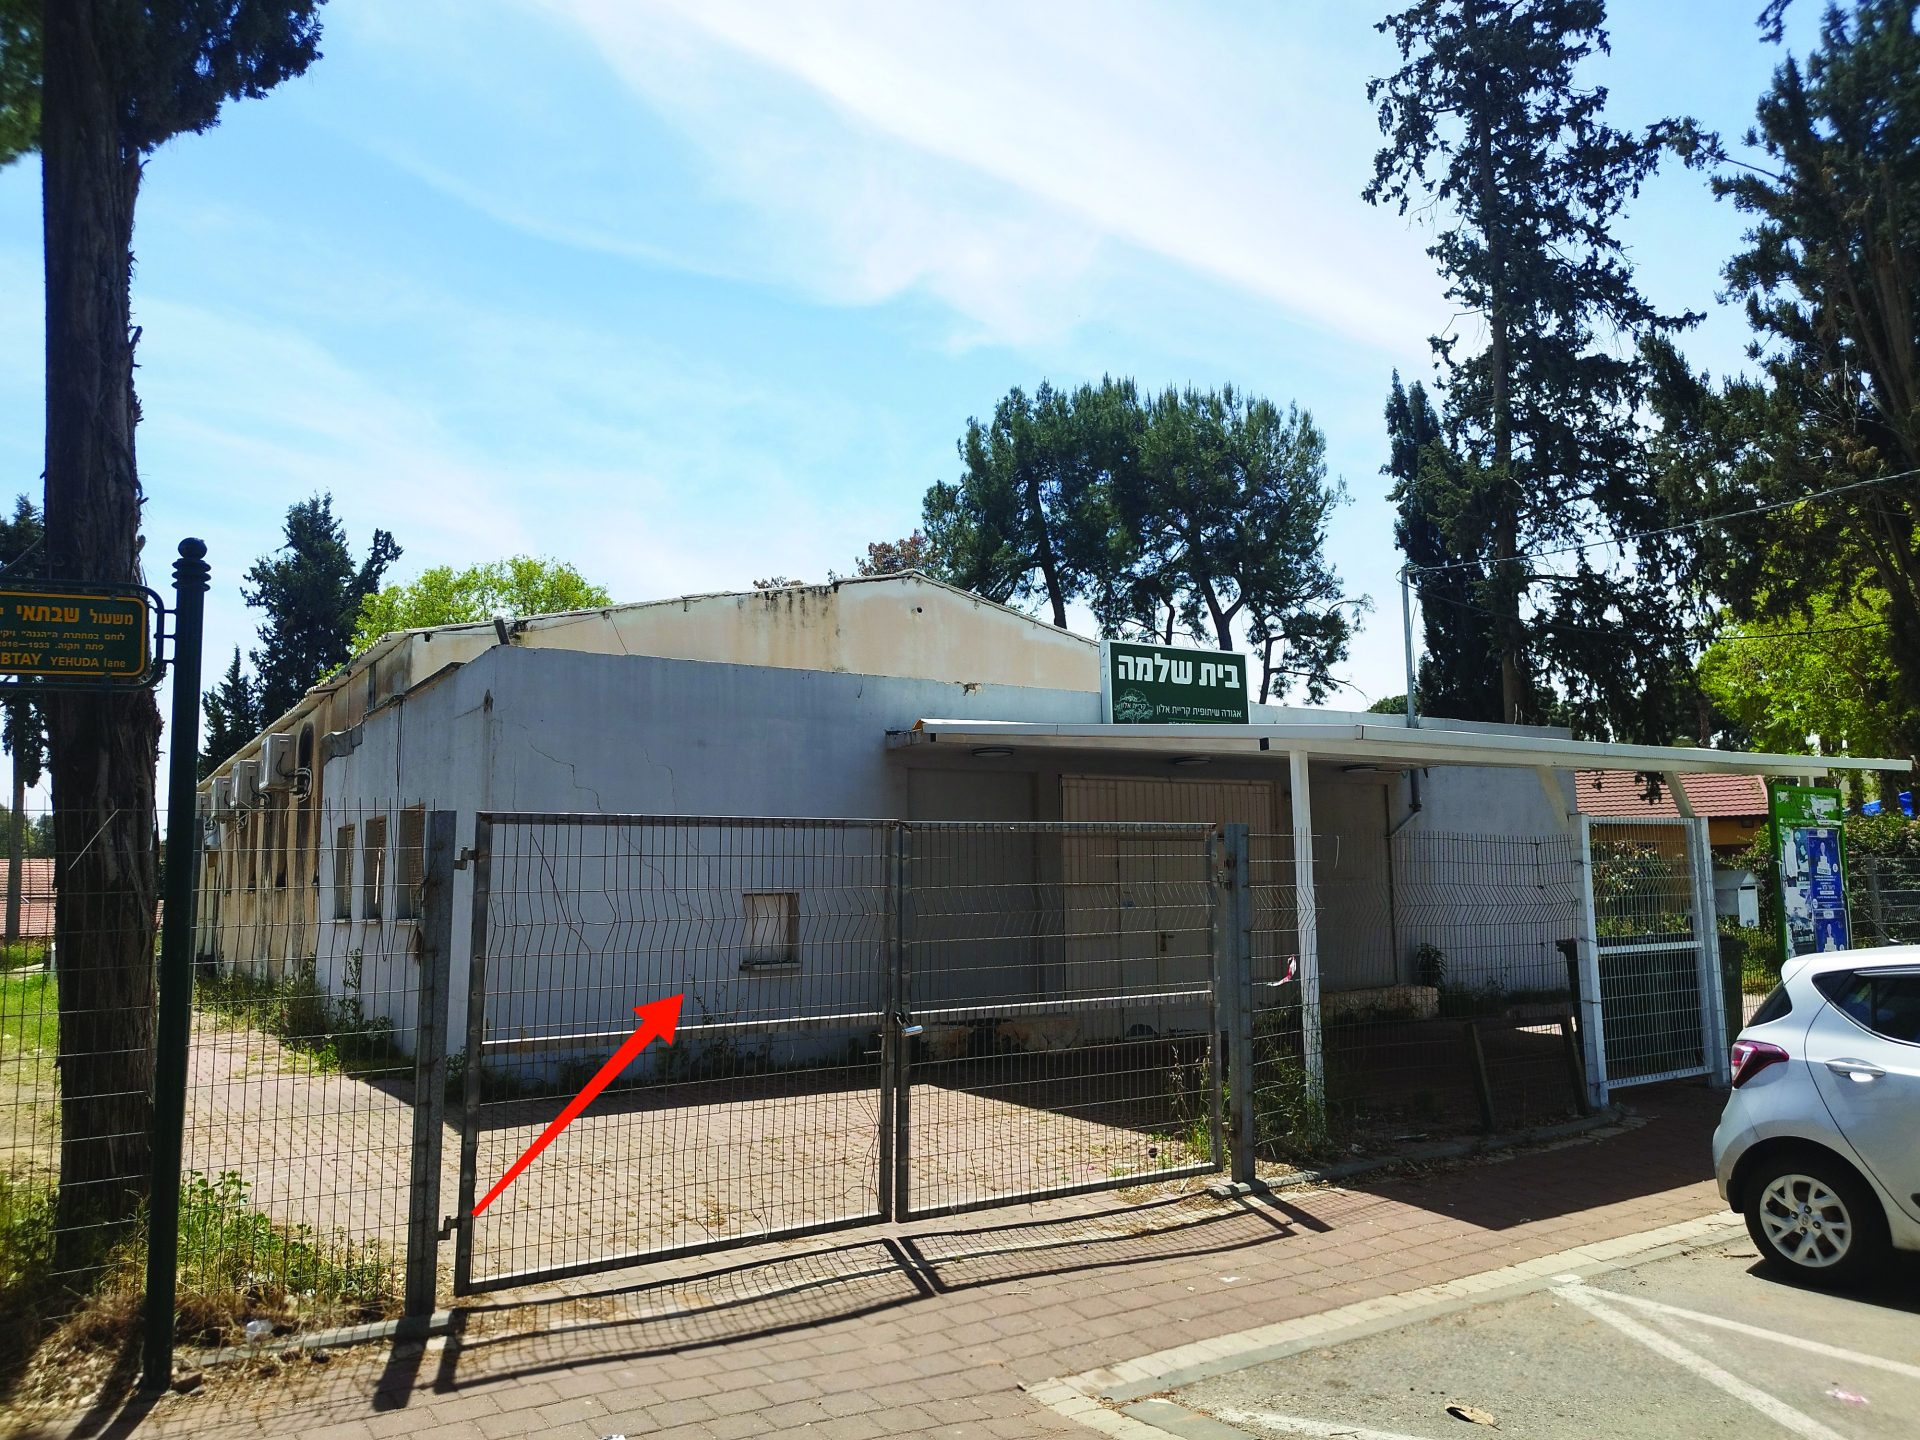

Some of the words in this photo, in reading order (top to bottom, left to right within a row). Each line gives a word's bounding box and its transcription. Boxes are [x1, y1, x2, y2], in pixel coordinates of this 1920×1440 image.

[16, 605, 80, 623] שבתאי
[90, 608, 133, 625] משעול
[63, 632, 99, 640] במחתרת
[104, 632, 125, 640] לוחם
[0, 652, 42, 665] BTAY
[50, 656, 99, 667] YEHUDA
[104, 657, 126, 668] lane
[1118, 652, 1193, 685] שלמה
[1198, 662, 1241, 689] בית
[1156, 703, 1171, 715] אלון
[1171, 705, 1191, 717] קריית
[1192, 706, 1220, 717] שיתופית
